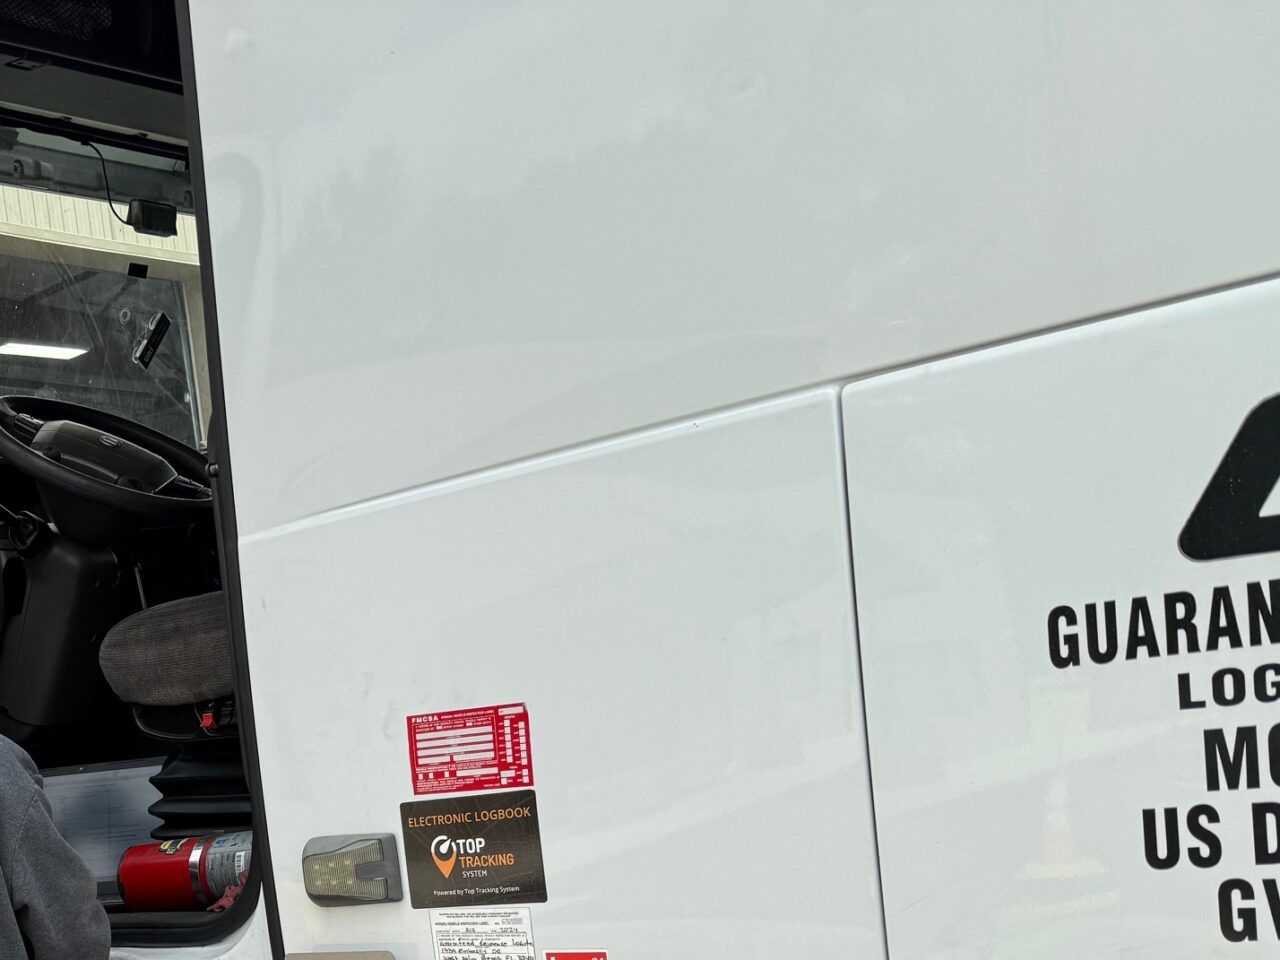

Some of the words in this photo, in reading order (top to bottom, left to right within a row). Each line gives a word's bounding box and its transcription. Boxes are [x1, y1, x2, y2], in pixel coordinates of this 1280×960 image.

[1047, 578, 1280, 669] GUARAN
[1177, 663, 1280, 710] LOG
[411, 715, 439, 723] FMCSA
[408, 812, 472, 828] ELECTRONIC
[474, 806, 531, 822] LOGBOOK
[1142, 803, 1223, 871] US
[456, 838, 486, 854] TOP
[459, 853, 515, 868] TRACKING
[462, 869, 487, 878] SYSTEM
[465, 888, 475, 896] Top
[476, 886, 499, 894] Tracking
